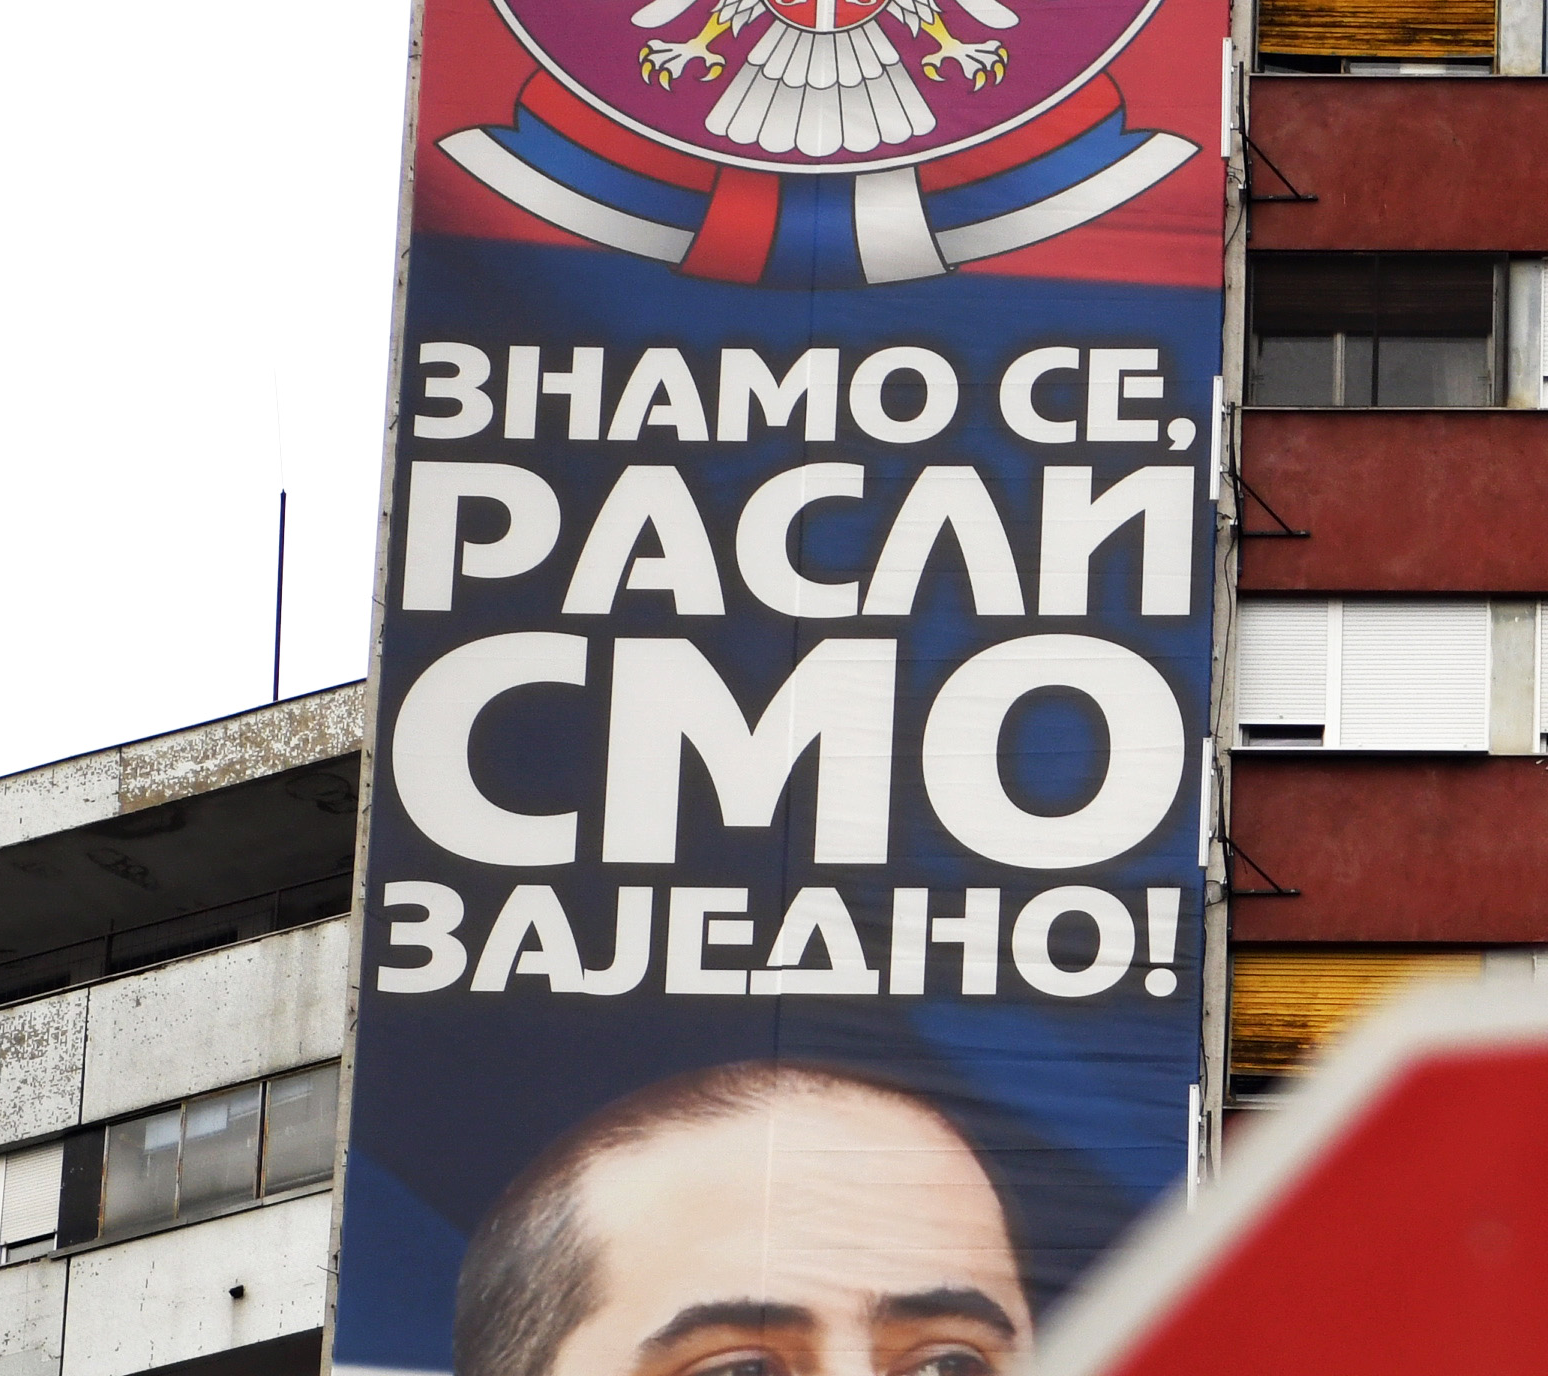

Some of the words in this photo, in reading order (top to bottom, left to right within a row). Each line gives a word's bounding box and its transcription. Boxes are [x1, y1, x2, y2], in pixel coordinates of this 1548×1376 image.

[414, 342, 959, 444] ЗНАМО
[1000, 347, 1197, 451] СЕ,
[403, 461, 1195, 619] РАСЛИ
[393, 632, 1185, 870] СМО
[378, 881, 1181, 998] ЗАЈЕДНО!
